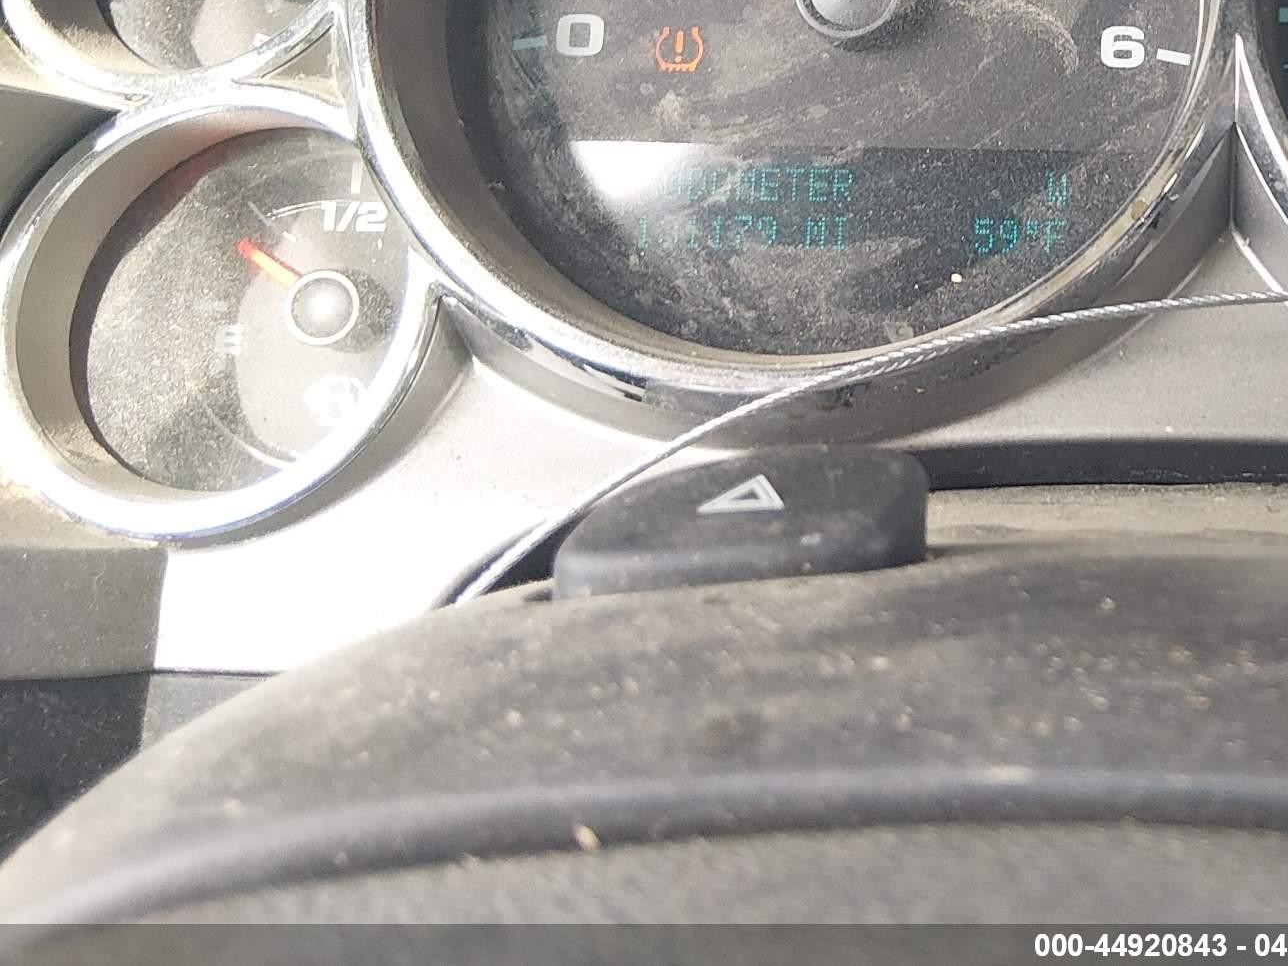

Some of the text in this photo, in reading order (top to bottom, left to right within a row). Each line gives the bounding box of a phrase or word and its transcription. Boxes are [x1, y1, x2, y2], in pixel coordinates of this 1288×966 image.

[555, 14, 604, 56] 0
[1100, 26, 1145, 69] 6
[321, 200, 388, 231] 1/2
